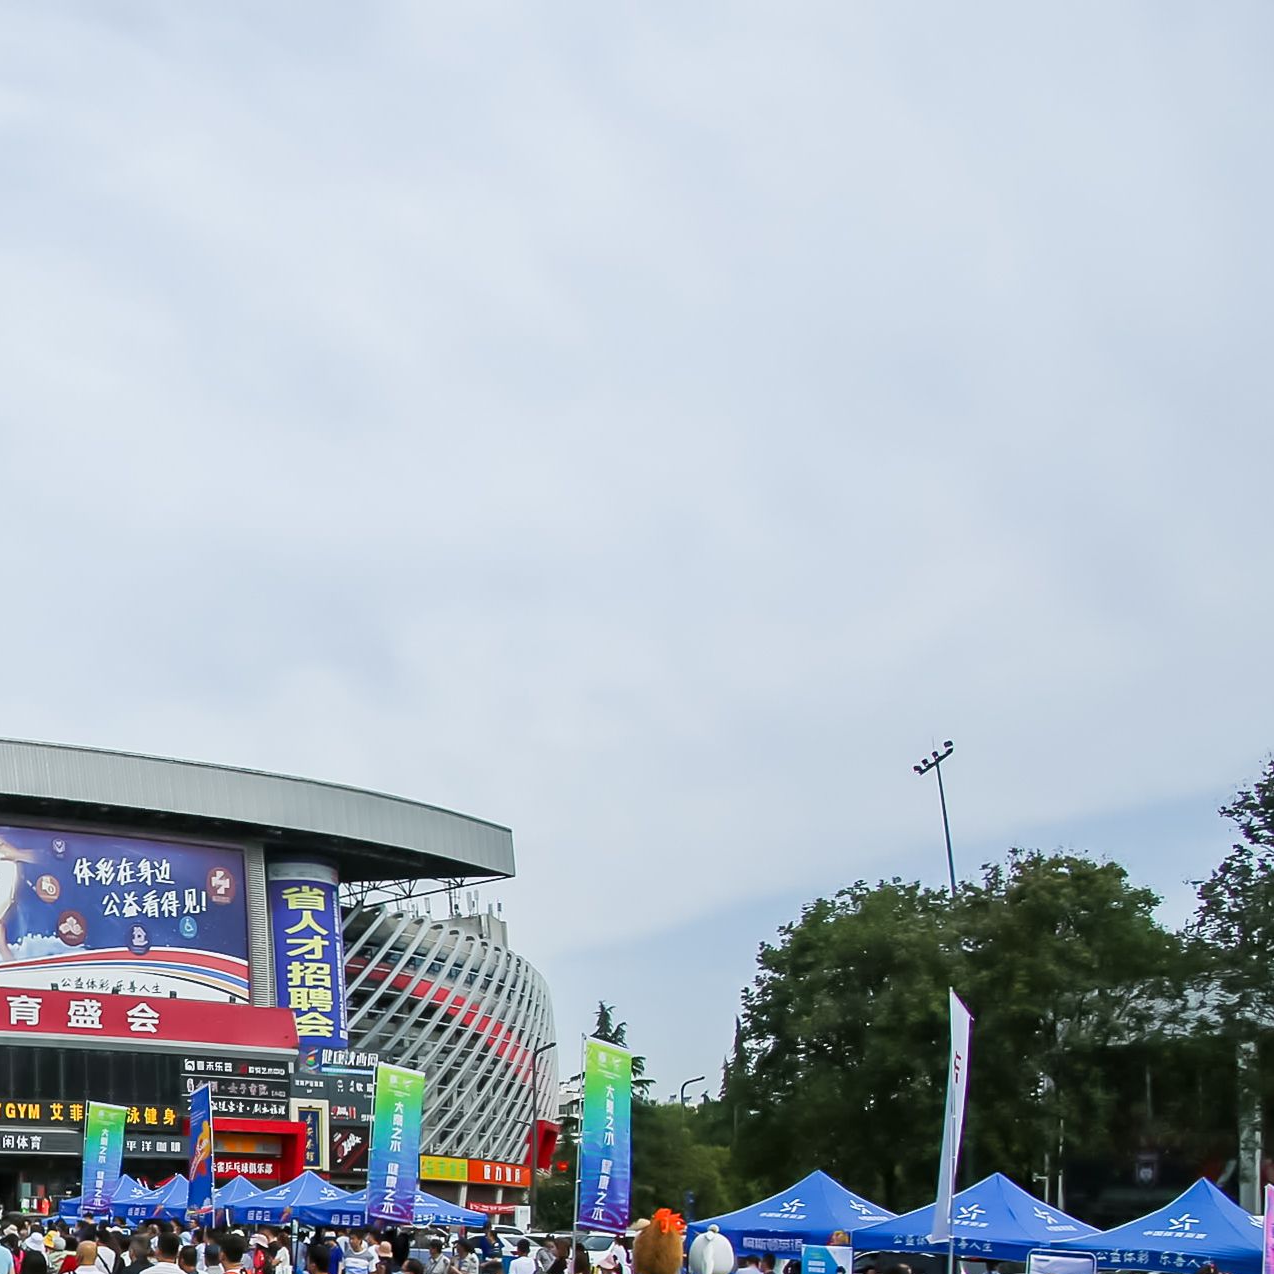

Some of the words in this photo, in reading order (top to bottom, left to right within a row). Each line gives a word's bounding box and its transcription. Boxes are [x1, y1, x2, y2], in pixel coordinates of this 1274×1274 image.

[73, 857, 175, 886] 体彩在身边
[281, 885, 335, 1038] 省人才招聘会
[5, 1102, 41, 1120] GYM
[125, 1140, 181, 1153] 平洋咖啡
[1096, 1248, 1150, 1264] 公益体彩
